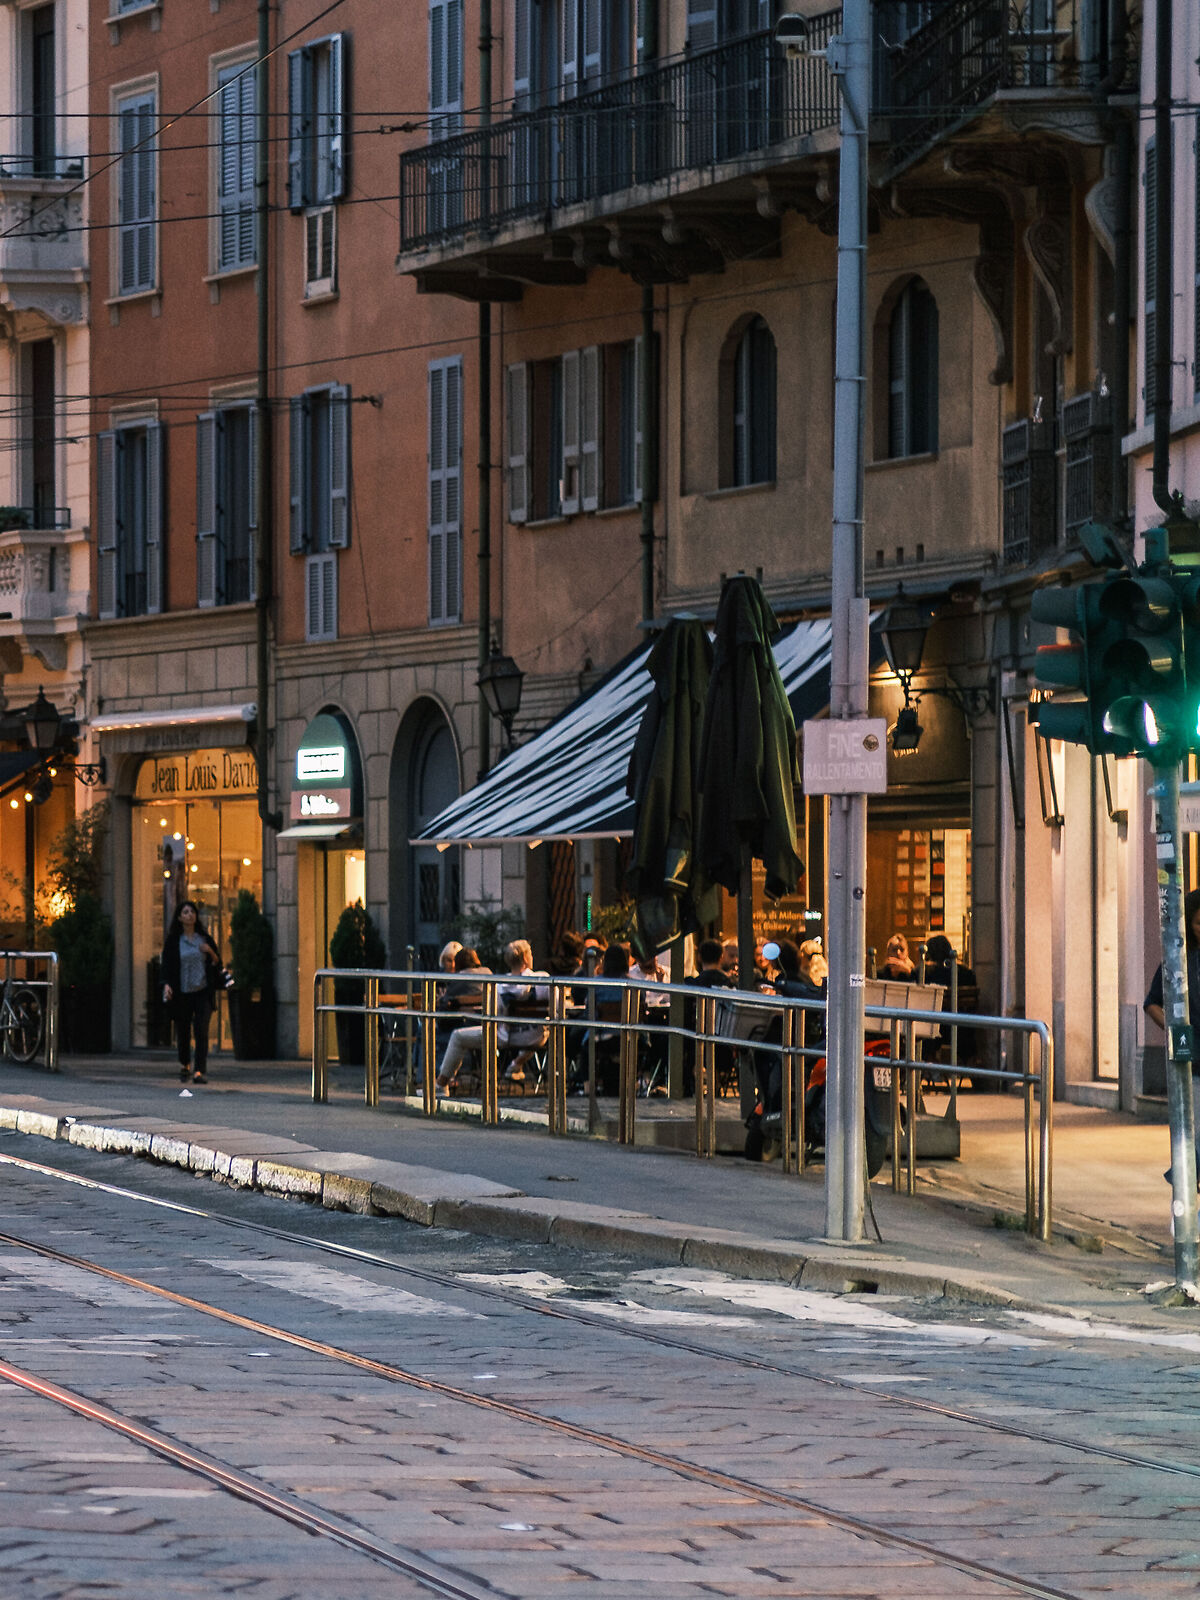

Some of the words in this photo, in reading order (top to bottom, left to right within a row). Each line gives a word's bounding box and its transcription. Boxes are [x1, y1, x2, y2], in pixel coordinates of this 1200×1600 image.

[828, 733, 861, 758] FINE
[152, 758, 180, 793] Jean
[185, 756, 218, 791] Louis
[806, 762, 884, 780] RALLENTAMENTO
